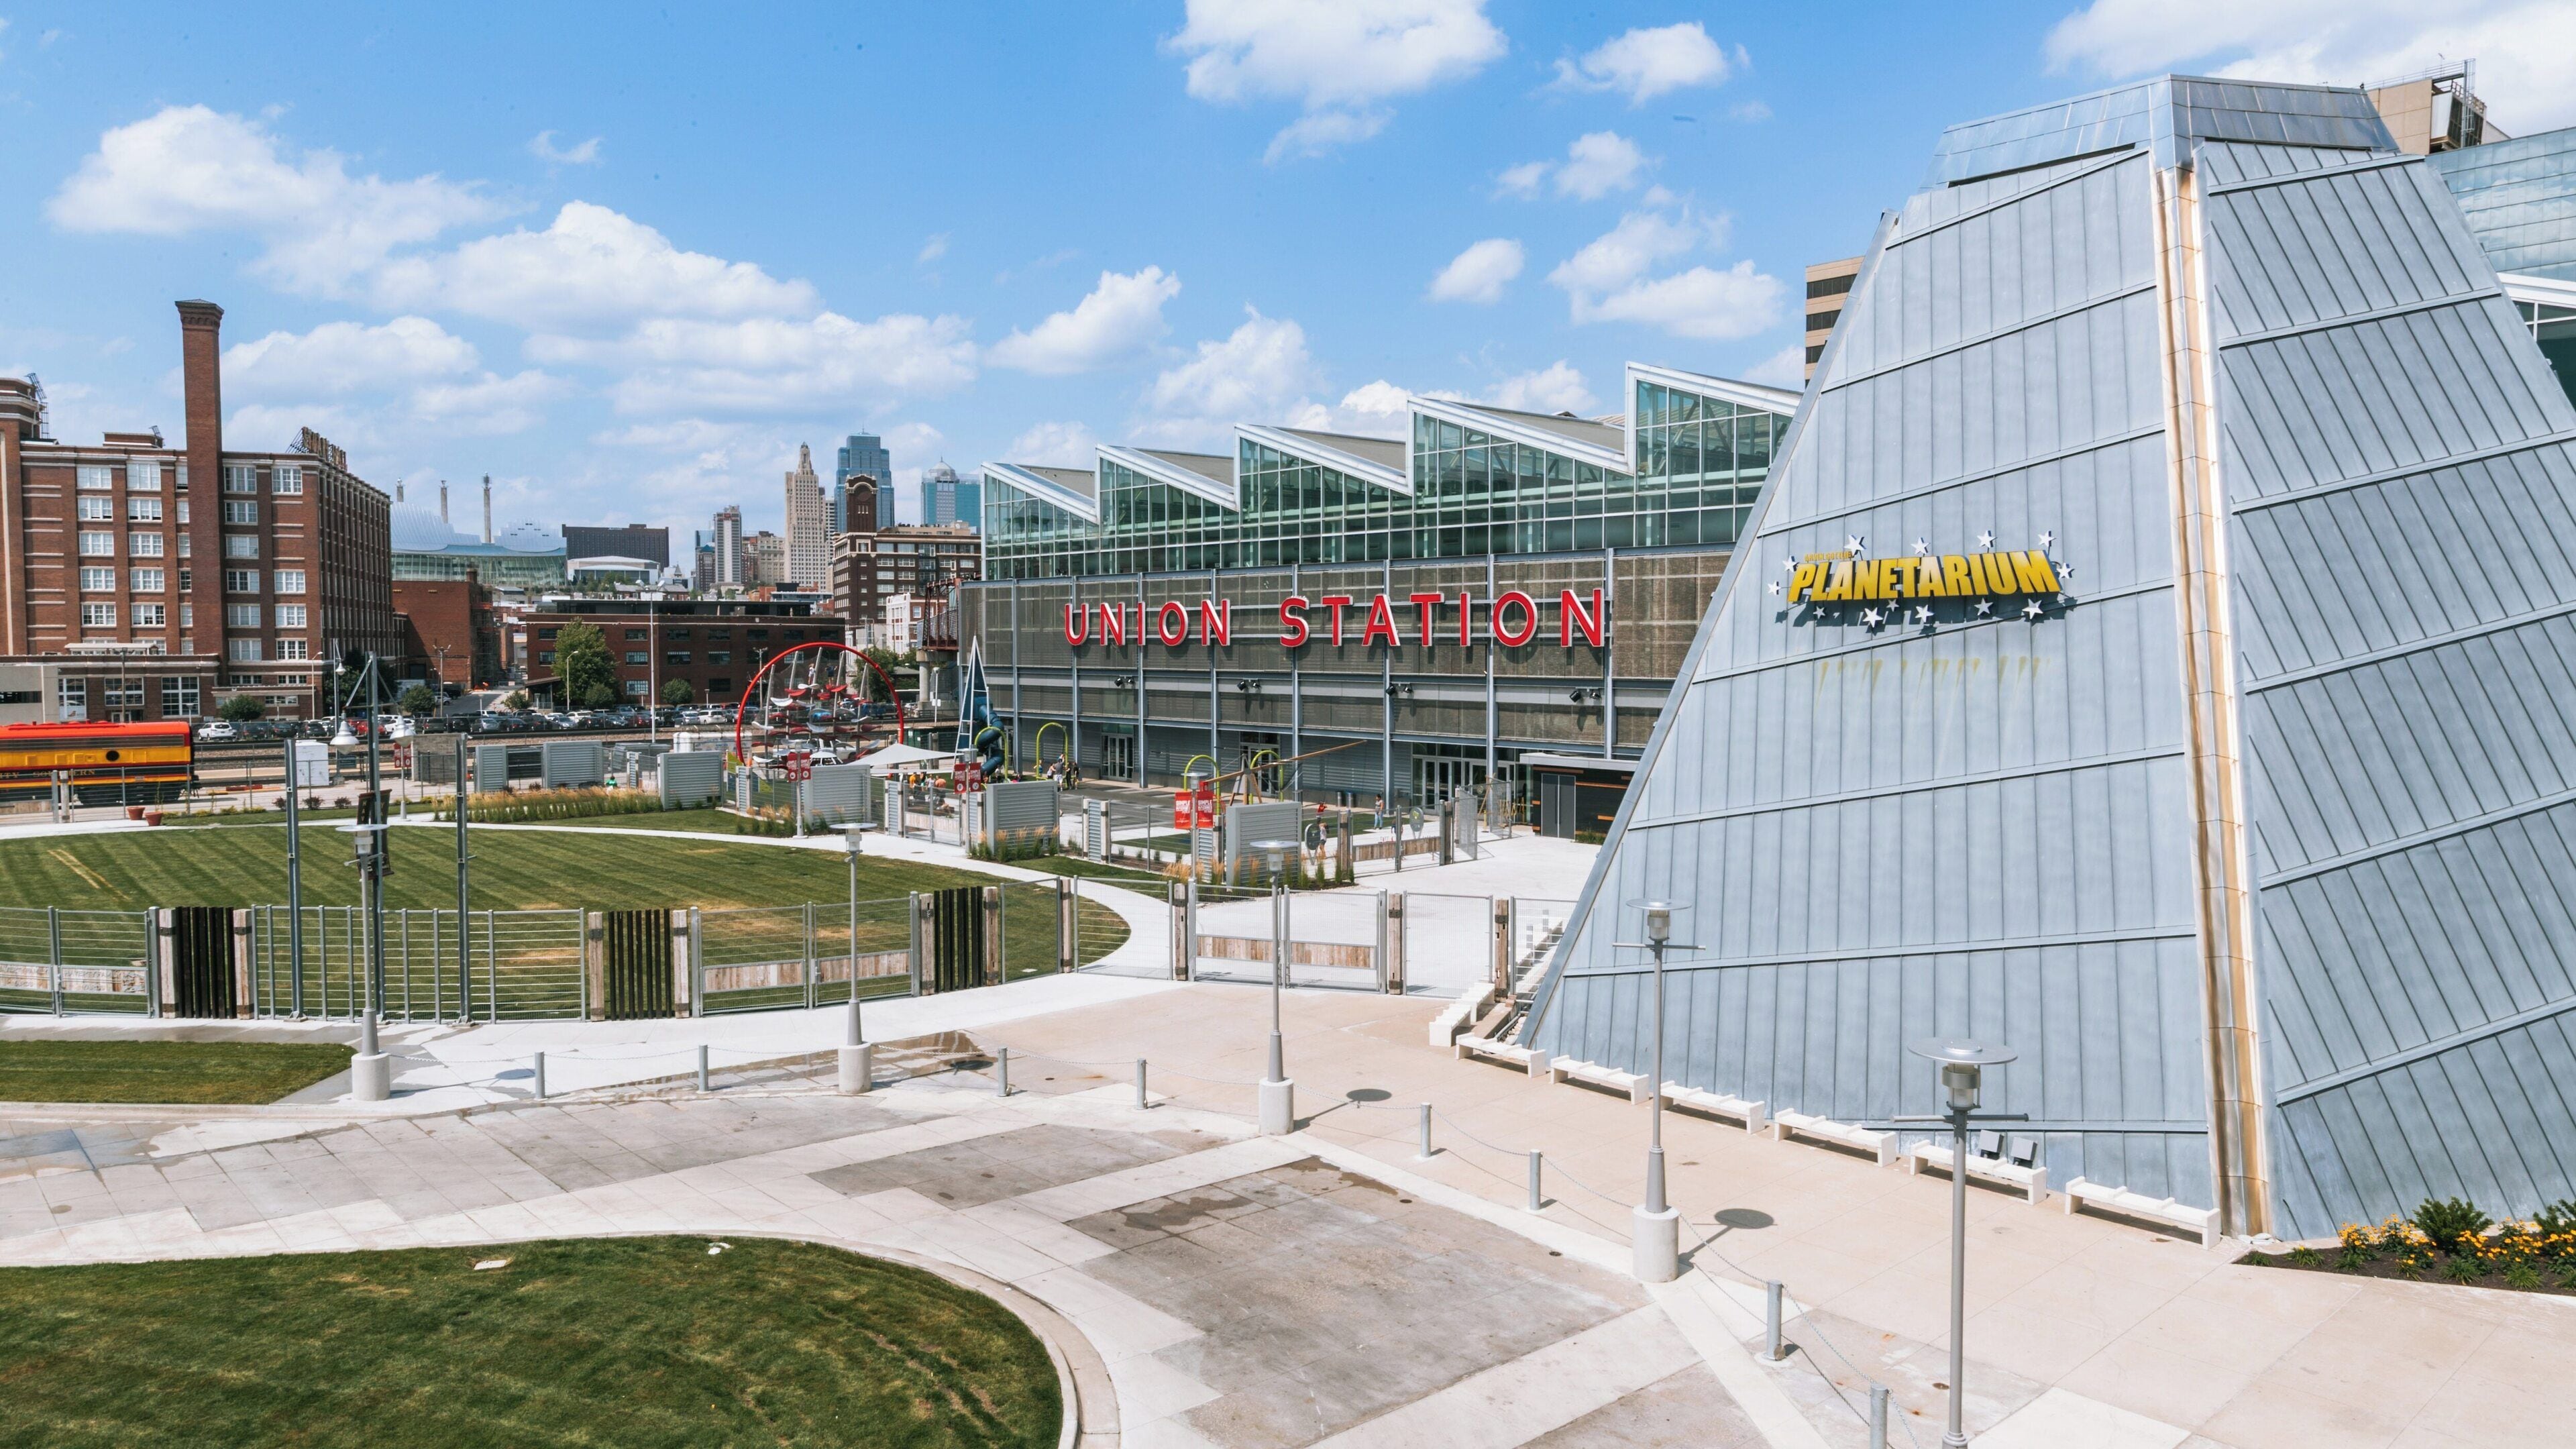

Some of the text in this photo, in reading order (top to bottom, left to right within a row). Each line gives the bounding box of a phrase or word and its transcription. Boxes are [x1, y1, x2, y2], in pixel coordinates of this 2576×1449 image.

[1787, 549, 2061, 603] PLANETARIUM
[1065, 588, 1605, 647] UNION STATION
